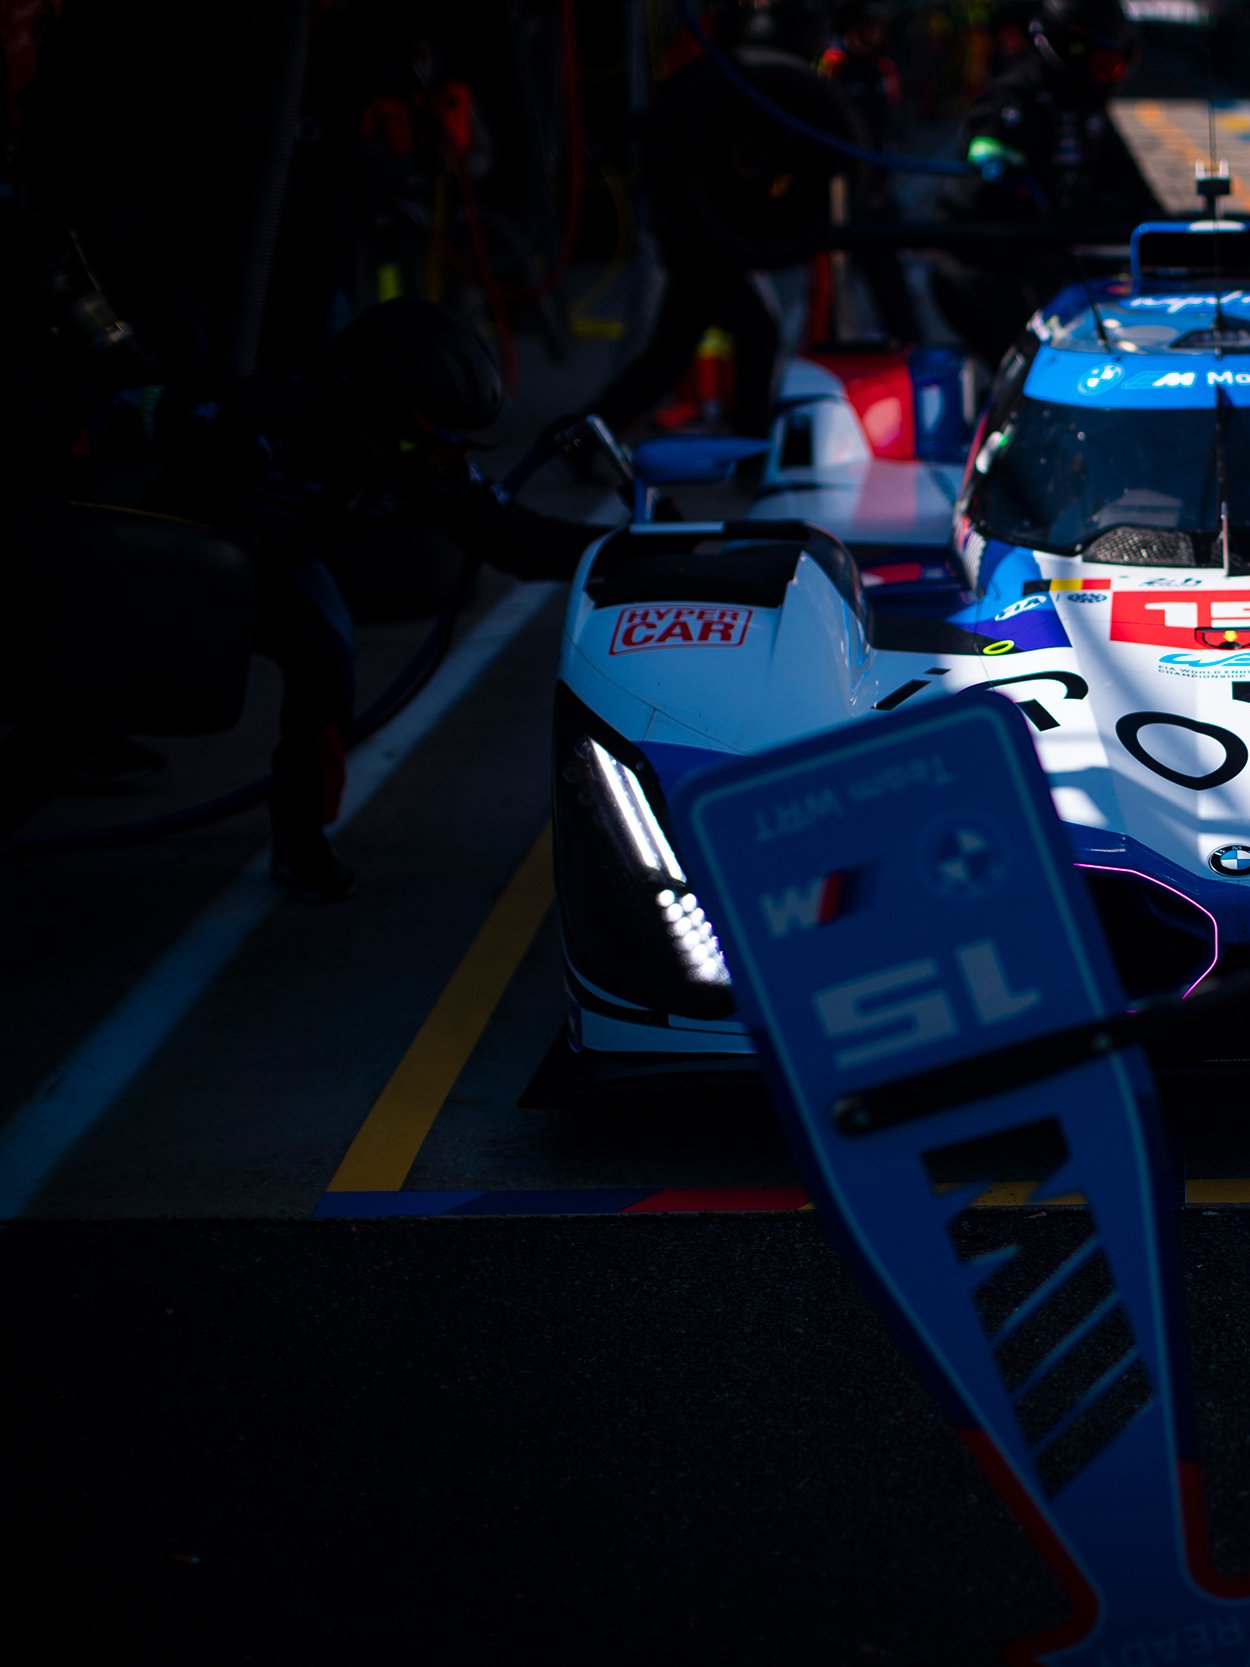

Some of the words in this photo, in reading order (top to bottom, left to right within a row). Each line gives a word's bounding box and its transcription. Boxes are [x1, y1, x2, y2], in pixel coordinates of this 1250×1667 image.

[628, 608, 740, 623] HYPER
[622, 621, 736, 647] CAR
[813, 940, 1040, 1069] 15
